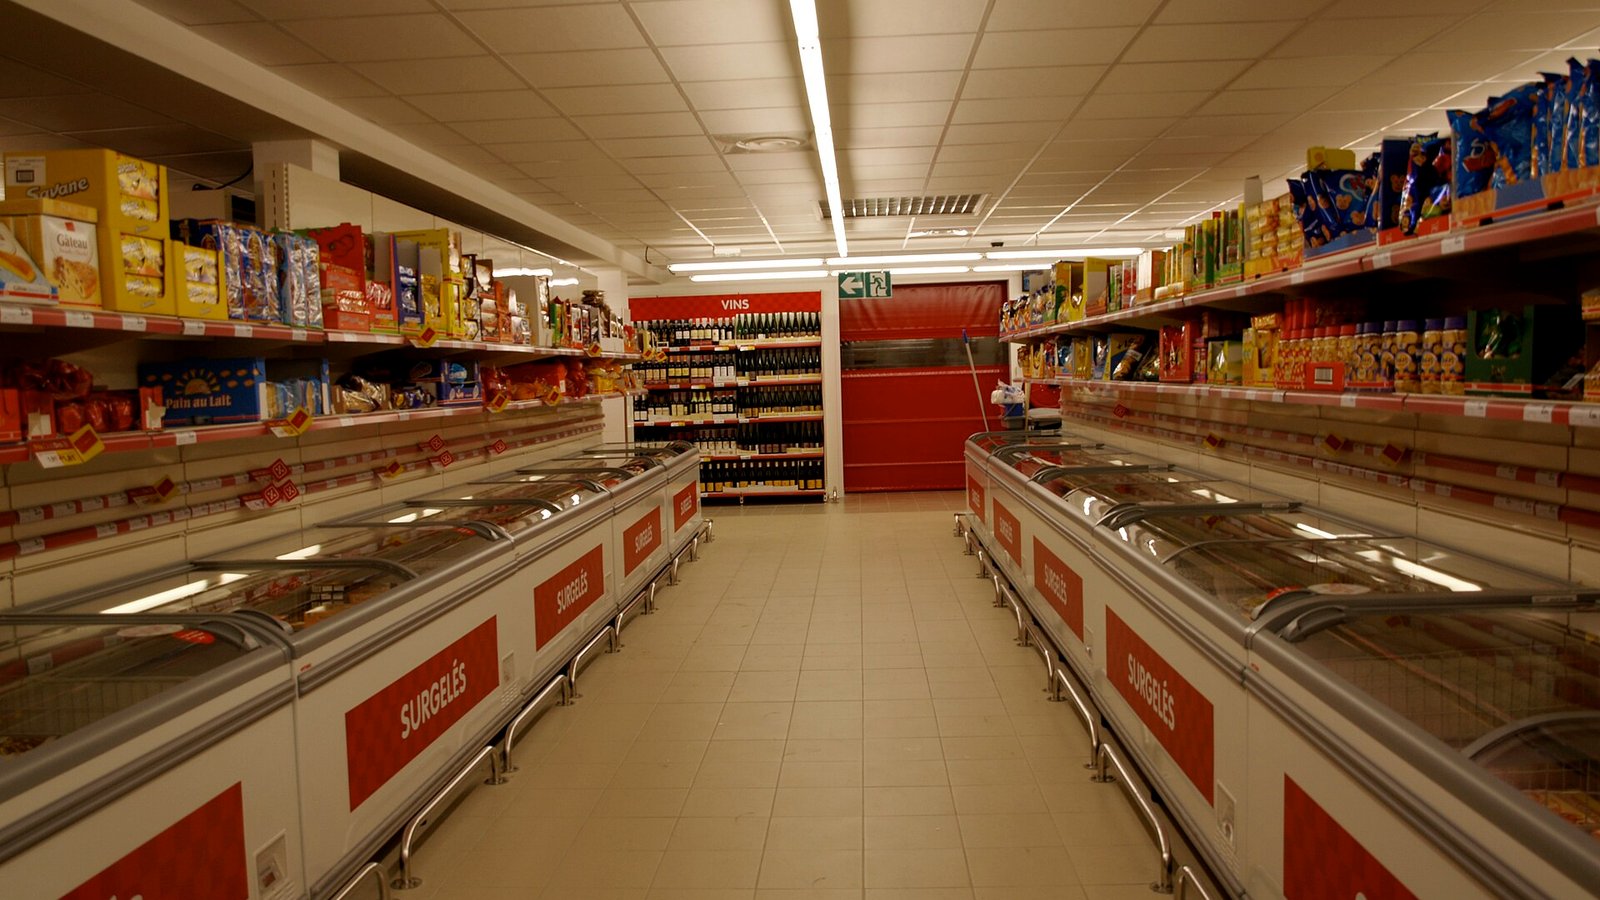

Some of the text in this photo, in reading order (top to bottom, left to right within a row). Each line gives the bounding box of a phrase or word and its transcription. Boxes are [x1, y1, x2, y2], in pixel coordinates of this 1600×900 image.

[26, 177, 90, 200] Savane
[56, 233, 89, 250] Gâteau
[721, 298, 750, 310] VINS
[166, 394, 232, 409] Pain au Lait
[556, 568, 589, 615] SURGELÉS
[1044, 563, 1068, 606] SURGELÉS
[400, 657, 467, 740] SURGELÉS
[1127, 652, 1175, 732] SURGELÉS
